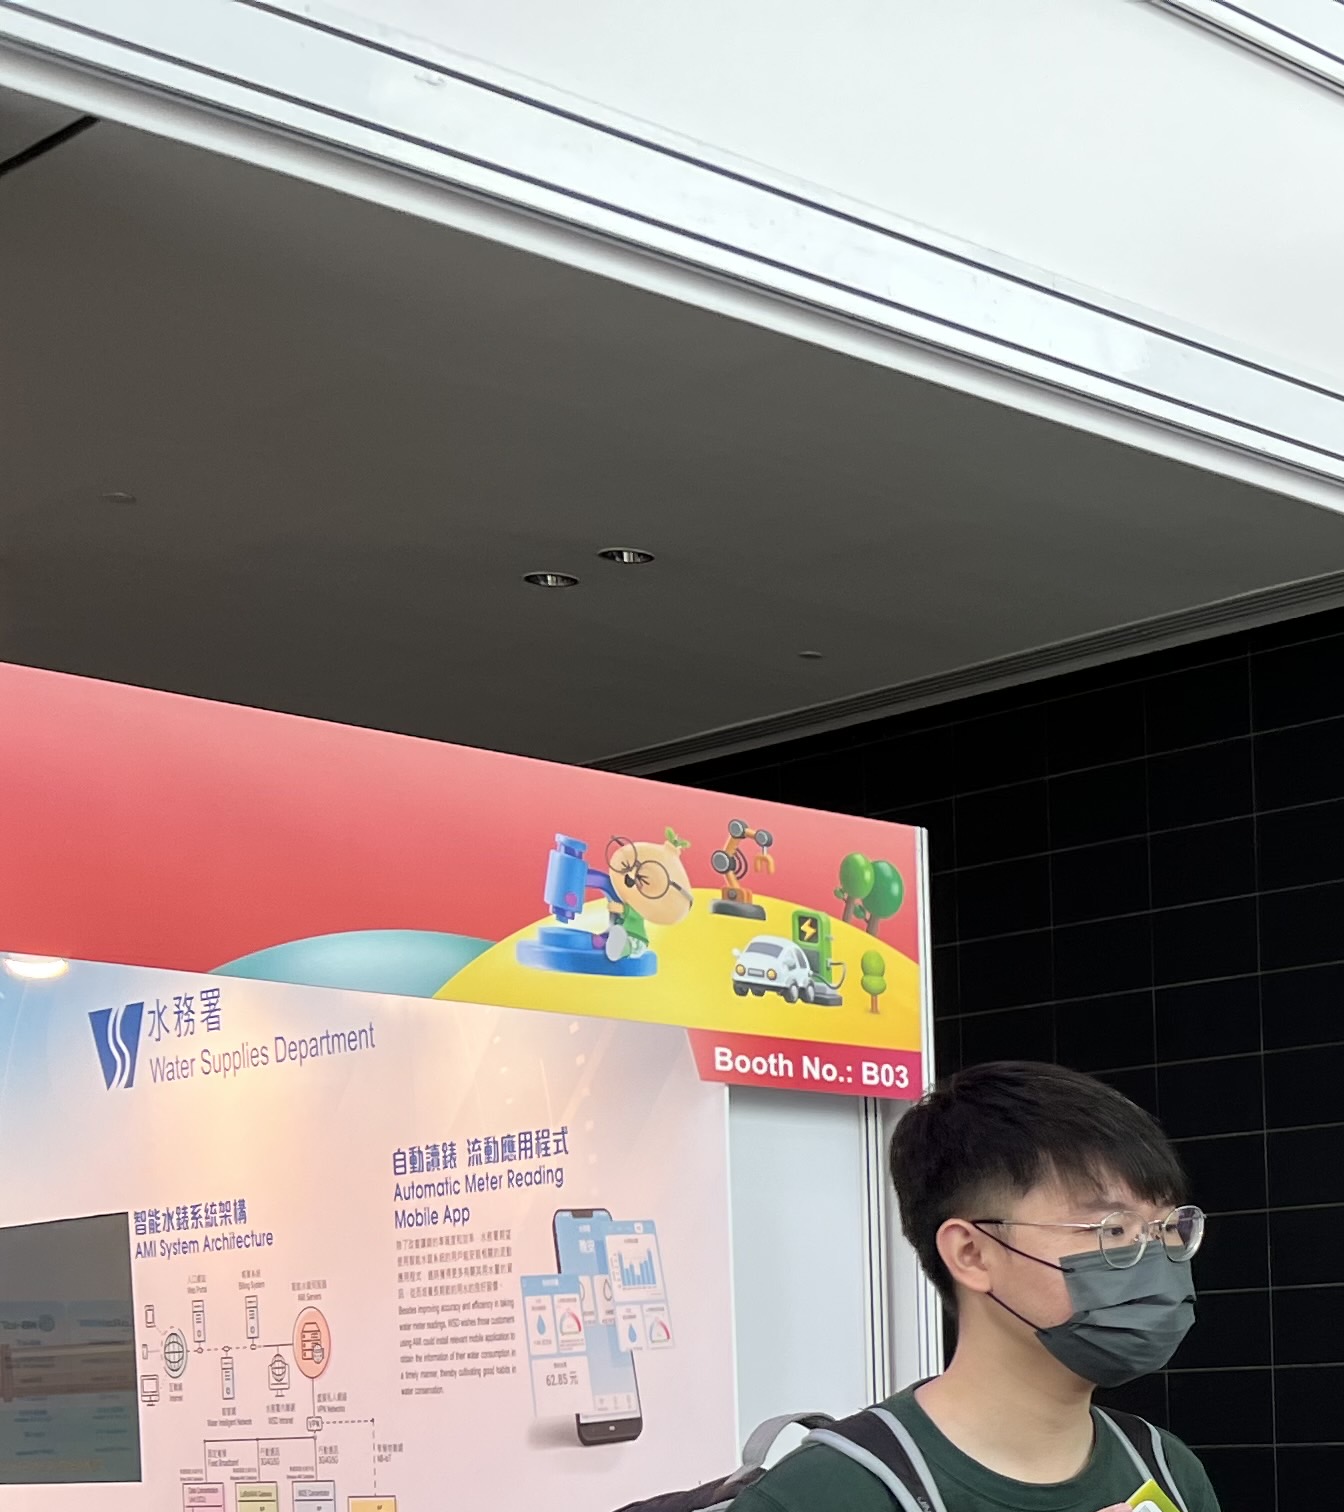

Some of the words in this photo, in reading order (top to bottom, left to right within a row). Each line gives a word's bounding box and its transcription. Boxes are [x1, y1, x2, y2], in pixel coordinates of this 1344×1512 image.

[147, 987, 222, 1042] 水務署
[150, 1056, 196, 1084] Water
[200, 1042, 270, 1079] Supplies
[274, 1021, 376, 1067] Department
[714, 1046, 794, 1078] Booth
[802, 1055, 853, 1083] No.:
[861, 1061, 909, 1088] B03
[466, 1126, 569, 1167] 流動應用程式
[393, 1176, 461, 1202] Automatic
[465, 1172, 503, 1195] Meter
[507, 1165, 565, 1190] Reading
[394, 1203, 439, 1230] Mobile
[443, 1204, 471, 1228] App
[135, 1241, 157, 1260] AMI
[160, 1236, 200, 1259] System
[203, 1230, 273, 1253] Architecture
[546, 1373, 568, 1387] 62.85
